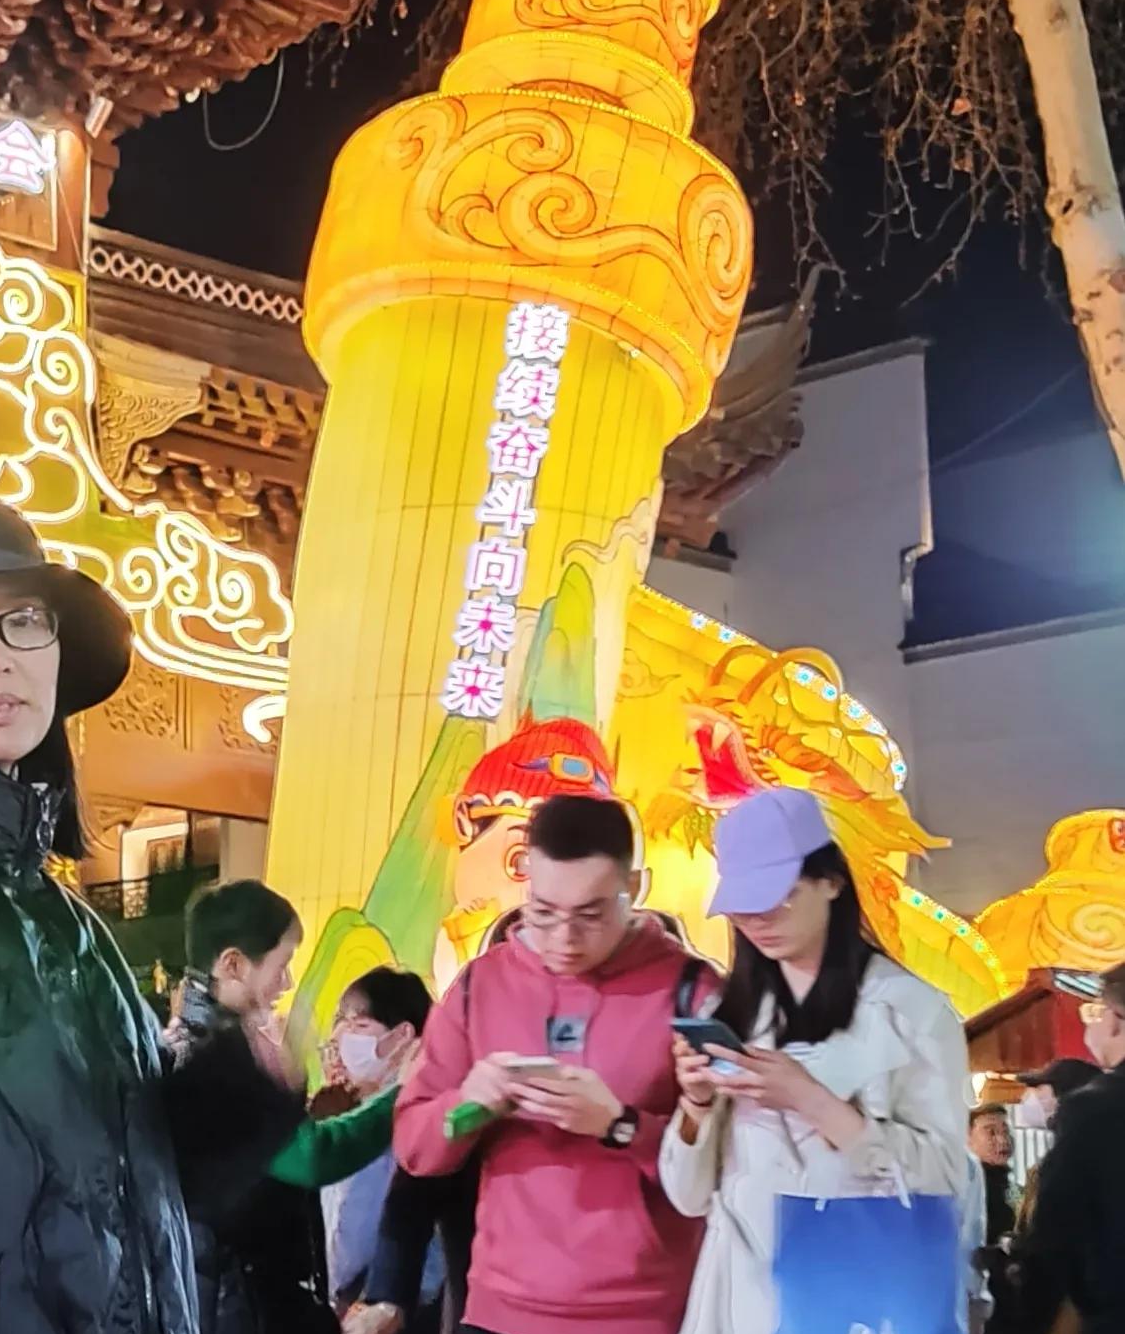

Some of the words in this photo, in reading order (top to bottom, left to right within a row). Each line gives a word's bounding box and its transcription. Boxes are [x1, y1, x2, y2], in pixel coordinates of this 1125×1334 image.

[442, 302, 570, 718] 接续奋斗向未来
